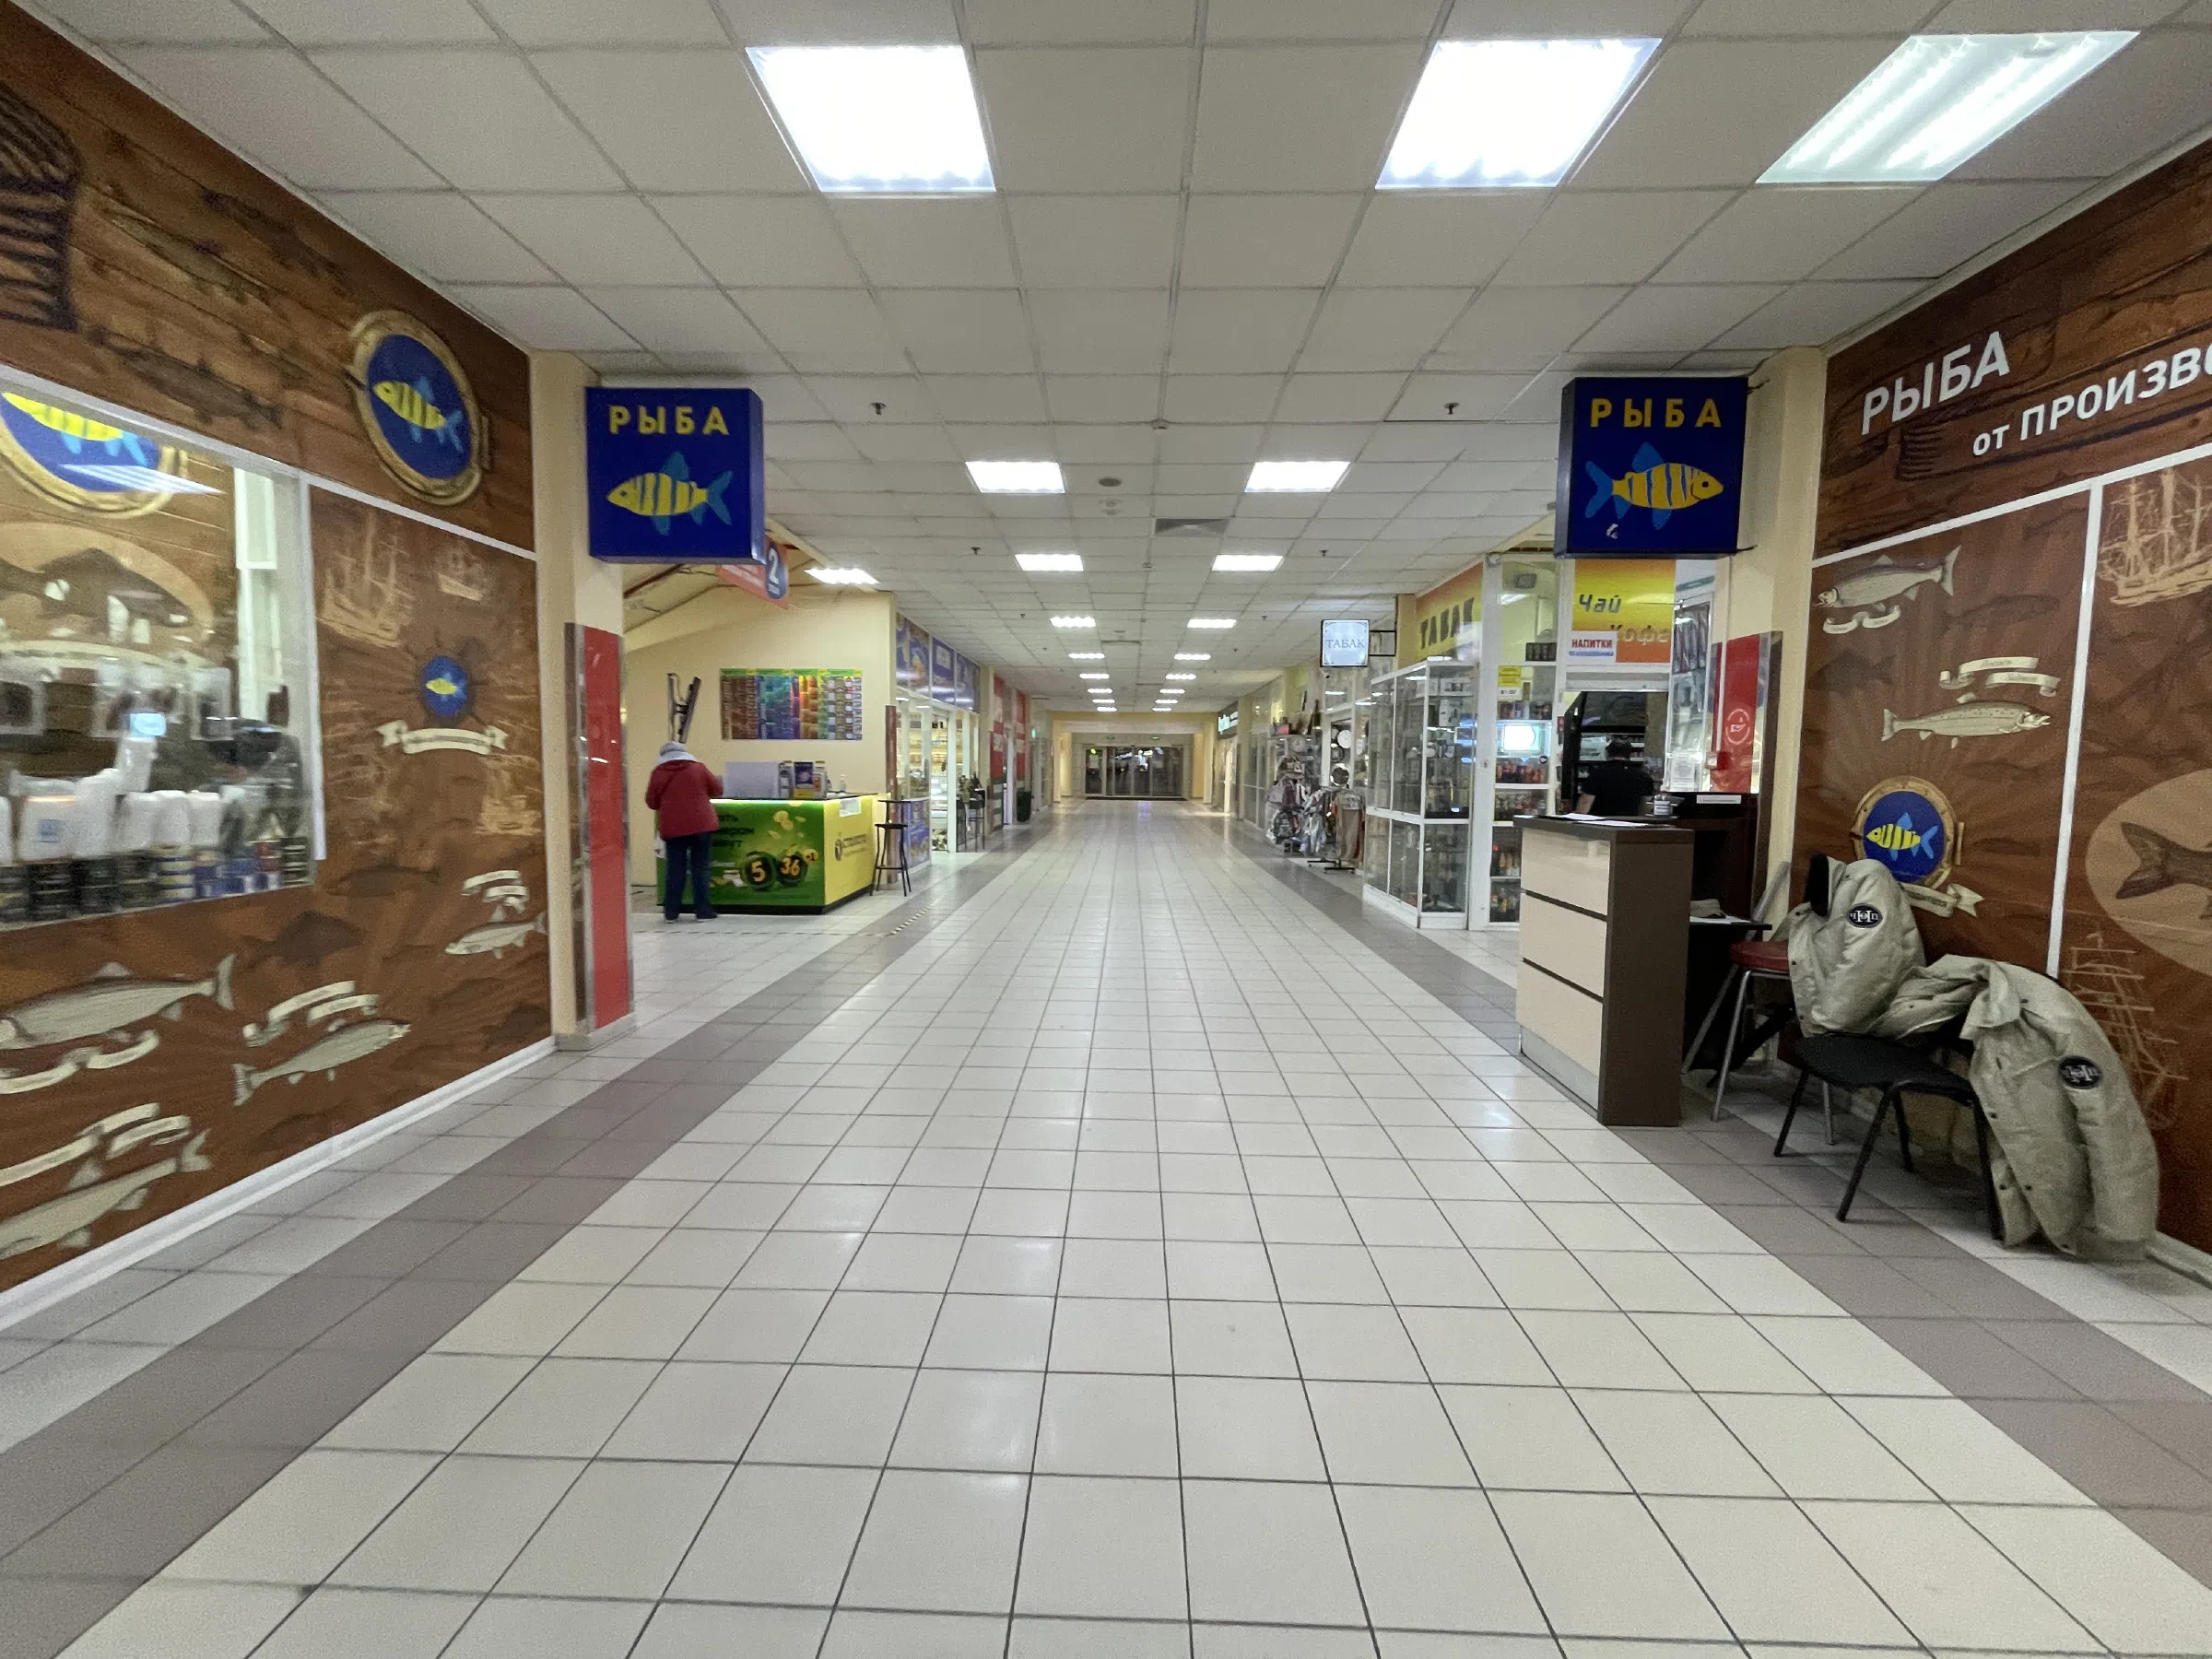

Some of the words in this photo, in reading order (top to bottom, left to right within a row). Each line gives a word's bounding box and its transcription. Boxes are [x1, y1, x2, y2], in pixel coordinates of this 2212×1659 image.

[1861, 331, 2010, 435] РЫБА
[1590, 397, 1722, 428] РЫБА
[1972, 424, 2010, 456] от
[2019, 342, 2212, 441] ПРОИЗВ
[608, 406, 730, 435] РЫБА
[769, 547, 780, 584] 2
[1579, 594, 1622, 614] Чай
[1420, 597, 1475, 650] ТАБАК
[1325, 639, 1366, 649] ТАБАК
[1571, 639, 1613, 649] НАПИТКИ
[751, 860, 766, 882] 5
[781, 857, 800, 877] 36
